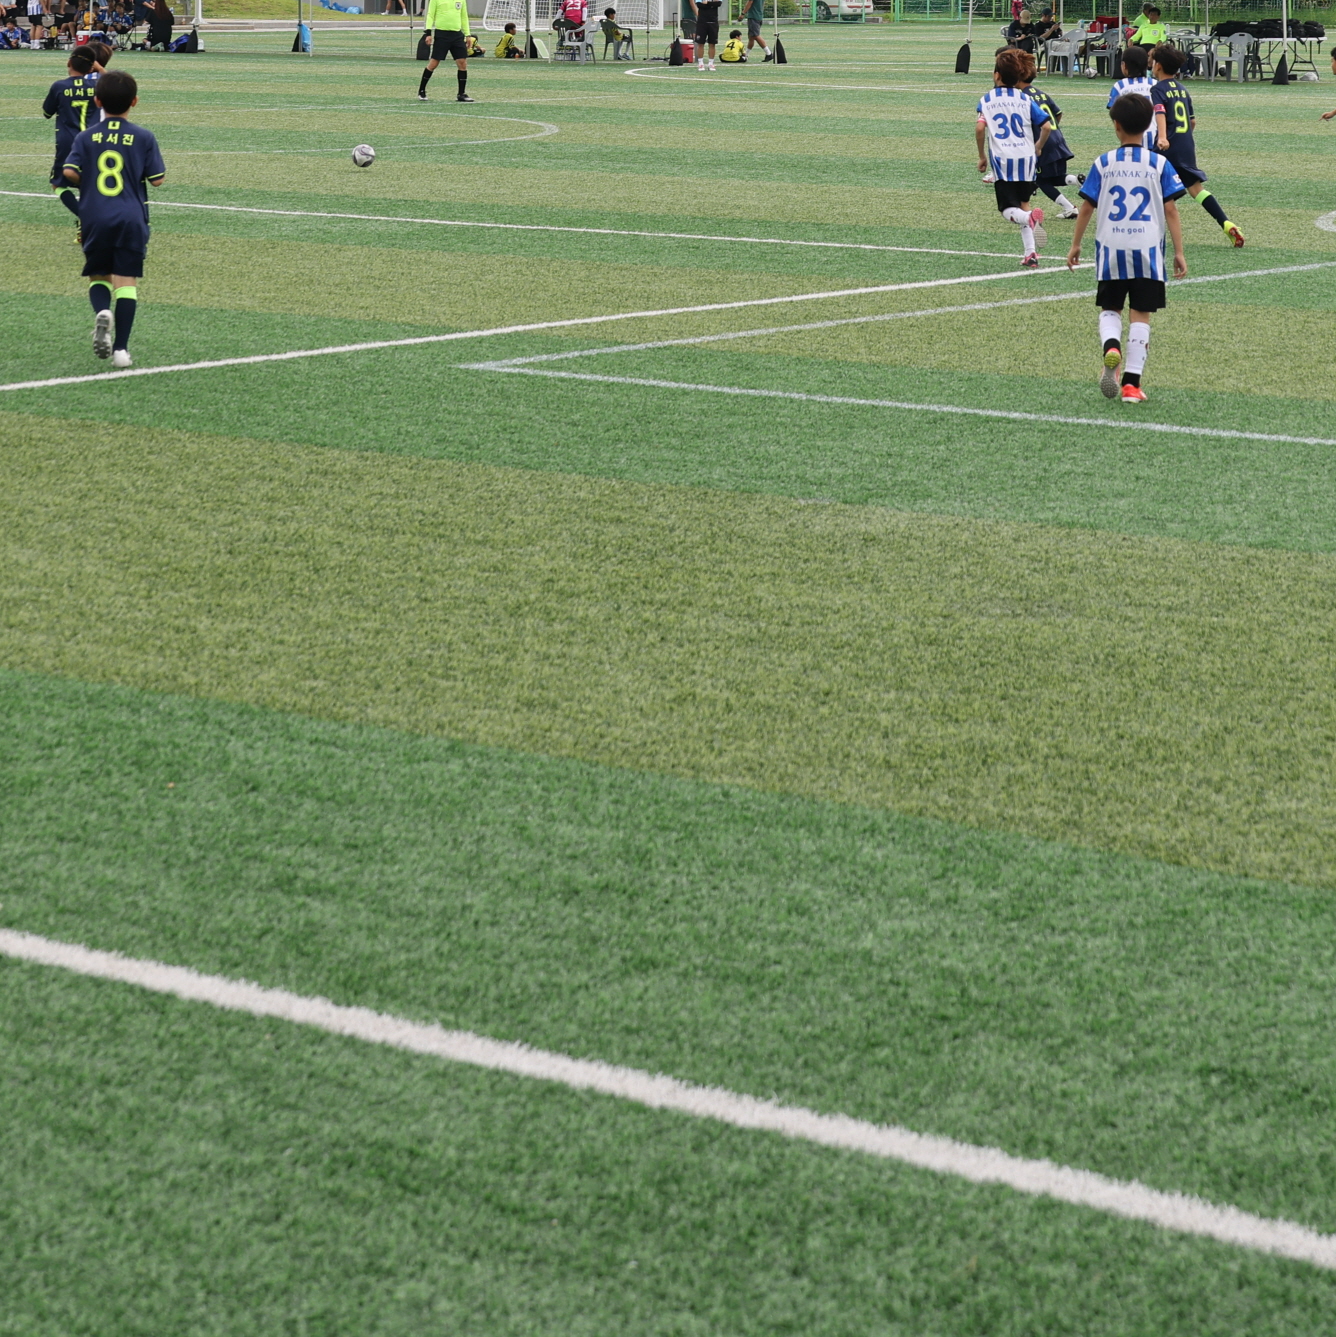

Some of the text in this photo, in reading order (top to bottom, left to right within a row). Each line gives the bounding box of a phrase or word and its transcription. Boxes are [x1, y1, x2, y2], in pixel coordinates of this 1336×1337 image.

[566, 0, 581, 11] 23
[726, 41, 735, 51] 4
[986, 102, 1015, 111] GWANAK
[71, 100, 90, 132] 7
[1174, 100, 1189, 133] 9
[992, 113, 1025, 140] 30
[91, 132, 134, 146] 박서진
[97, 149, 124, 197] 8
[1103, 170, 1156, 179] GWANAK FC
[1108, 185, 1151, 221] 32
[1127, 226, 1145, 235] goal
